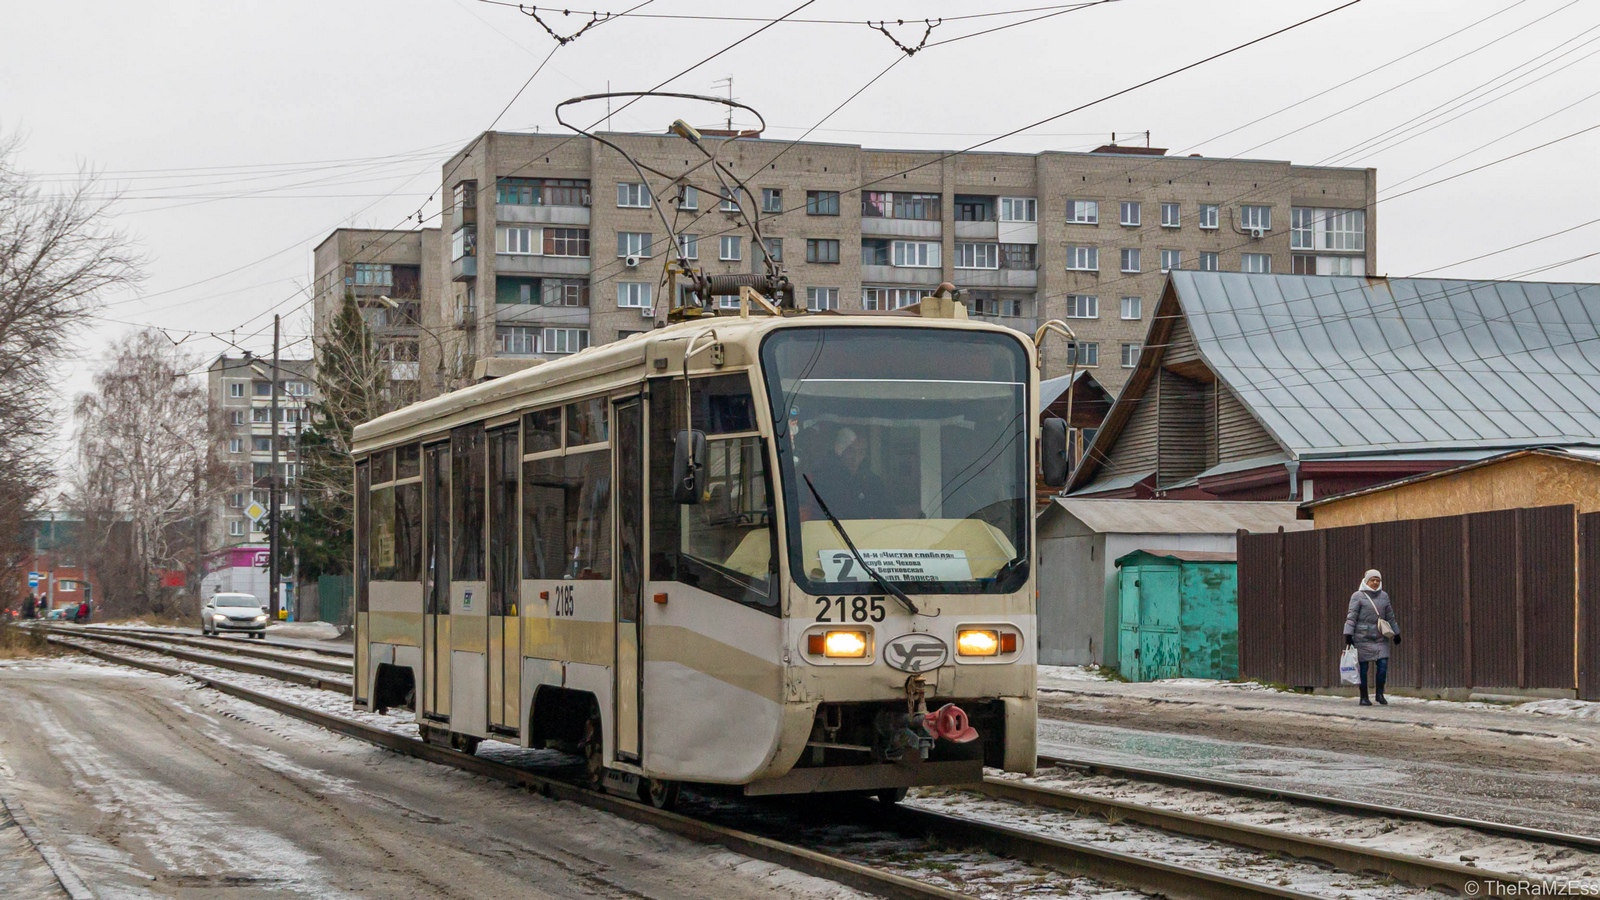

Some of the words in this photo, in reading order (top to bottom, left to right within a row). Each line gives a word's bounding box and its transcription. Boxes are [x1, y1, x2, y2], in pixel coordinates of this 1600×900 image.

[832, 553, 858, 582] 2
[555, 585, 574, 617] 2185
[815, 596, 886, 622] 2185
